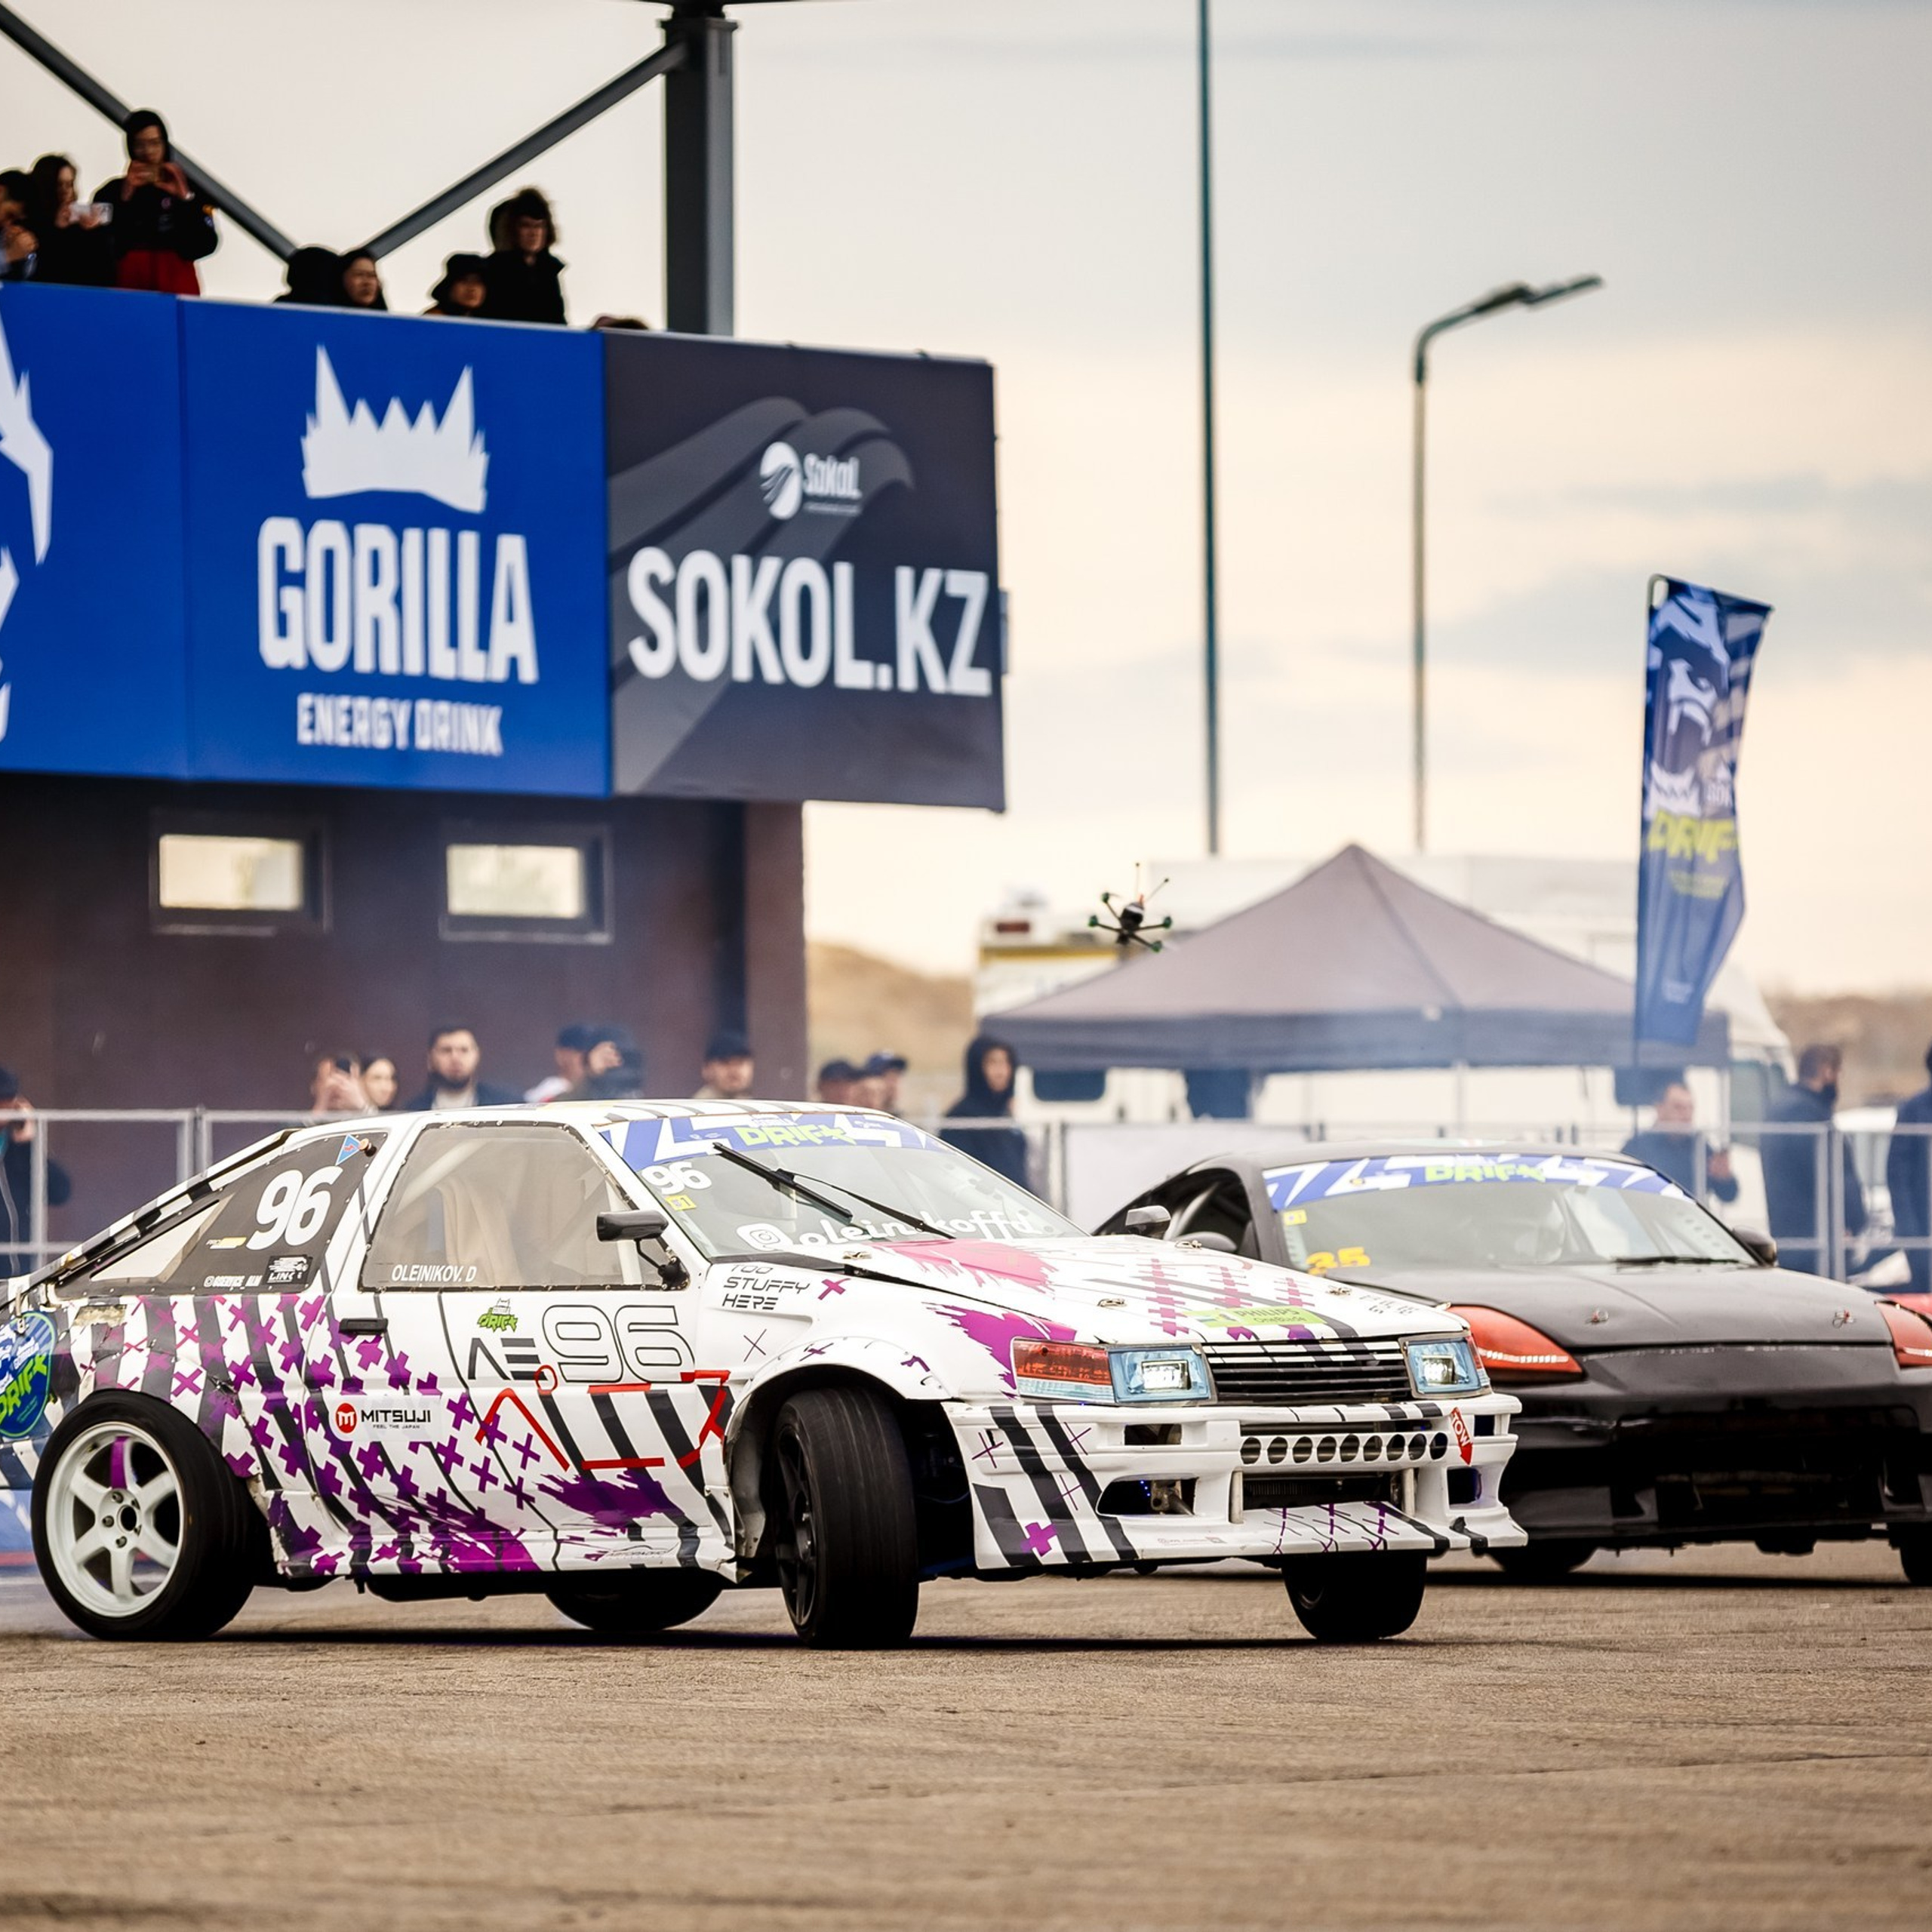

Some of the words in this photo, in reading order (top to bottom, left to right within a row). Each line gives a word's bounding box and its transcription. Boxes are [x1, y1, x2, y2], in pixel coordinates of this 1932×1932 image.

[258, 516, 539, 684] GORILLA
[628, 546, 992, 697] SOKOL.KZ
[297, 693, 412, 750] ENERGY
[414, 698, 503, 756] DRINK
[641, 1161, 712, 1195] 96
[246, 1166, 343, 1250] 96
[392, 1264, 463, 1282] OLEINIKOV.
[466, 1266, 477, 1282] D
[731, 1264, 774, 1275] TOO
[724, 1276, 811, 1294] STUFFY
[722, 1294, 778, 1310] HERE
[1234, 1308, 1300, 1316] PHILIPS
[361, 1410, 431, 1423] MITSUJI
[1452, 1412, 1471, 1447] TOW
